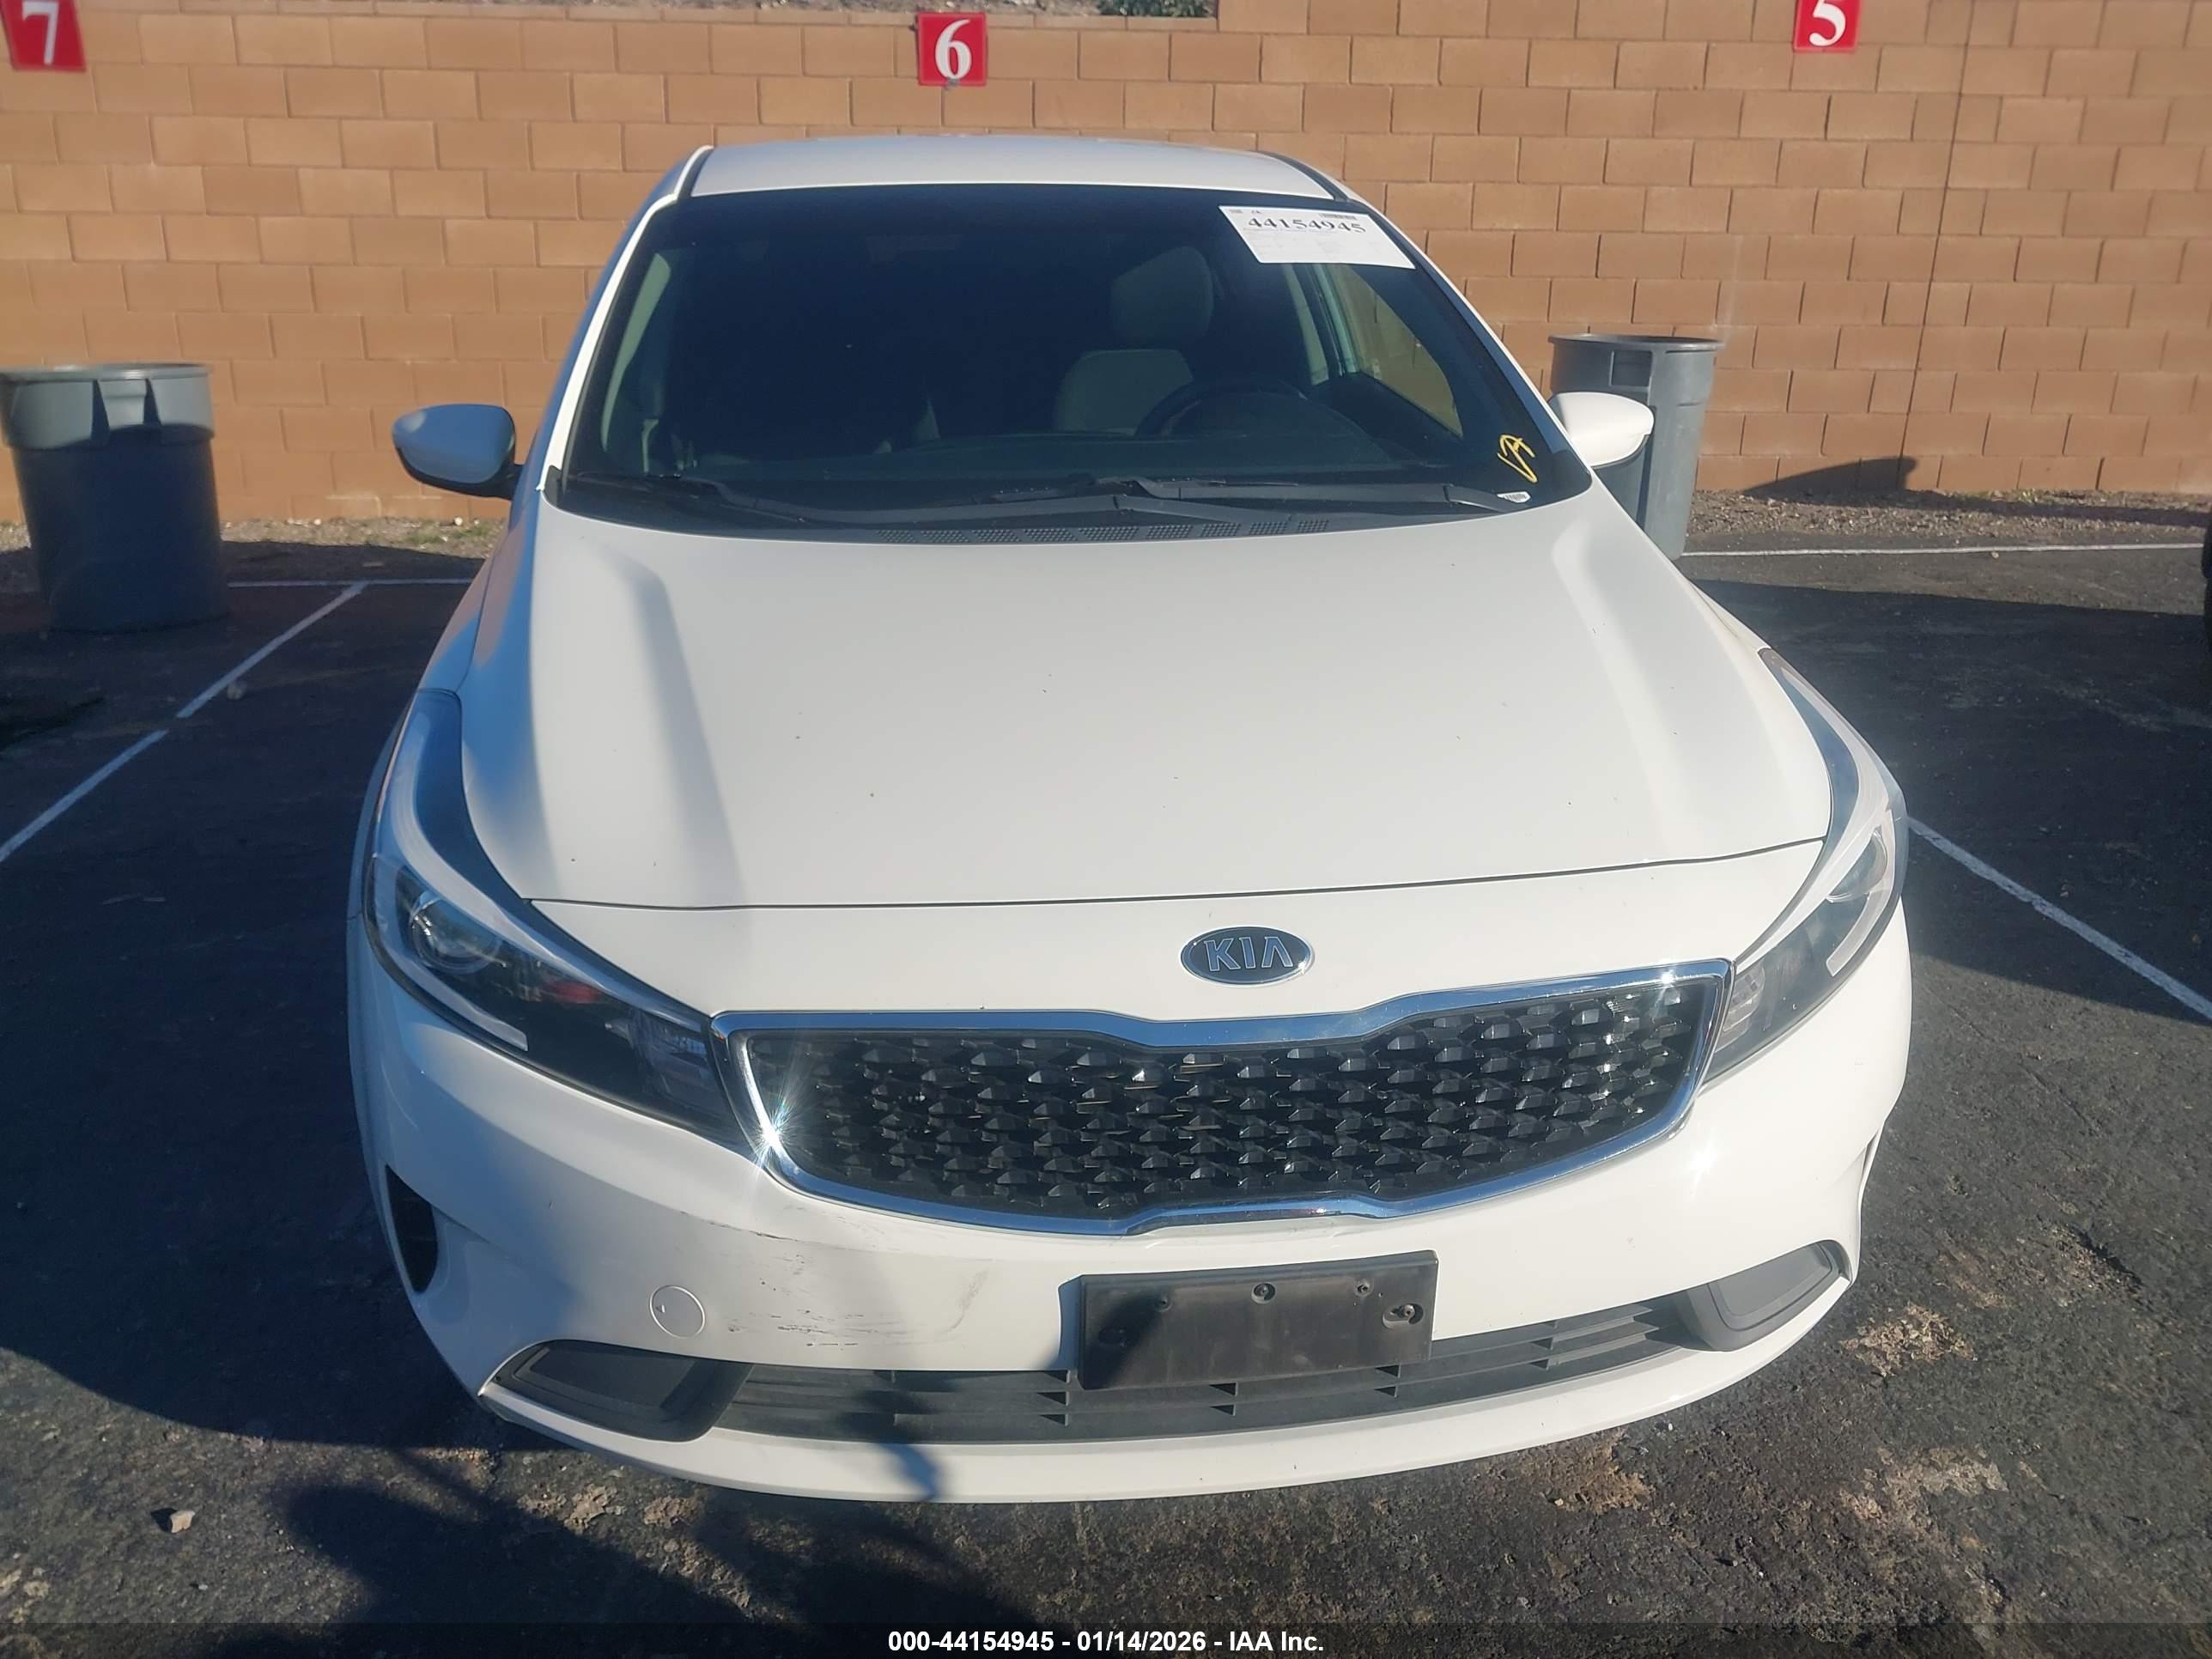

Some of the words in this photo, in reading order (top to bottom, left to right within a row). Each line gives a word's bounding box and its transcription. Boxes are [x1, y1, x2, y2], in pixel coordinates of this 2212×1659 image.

[21, 1, 59, 65] 7
[1808, 0, 1846, 46] 5
[934, 19, 972, 79] 6
[1249, 217, 1367, 233] 44154945
[1204, 936, 1294, 972] KIA
